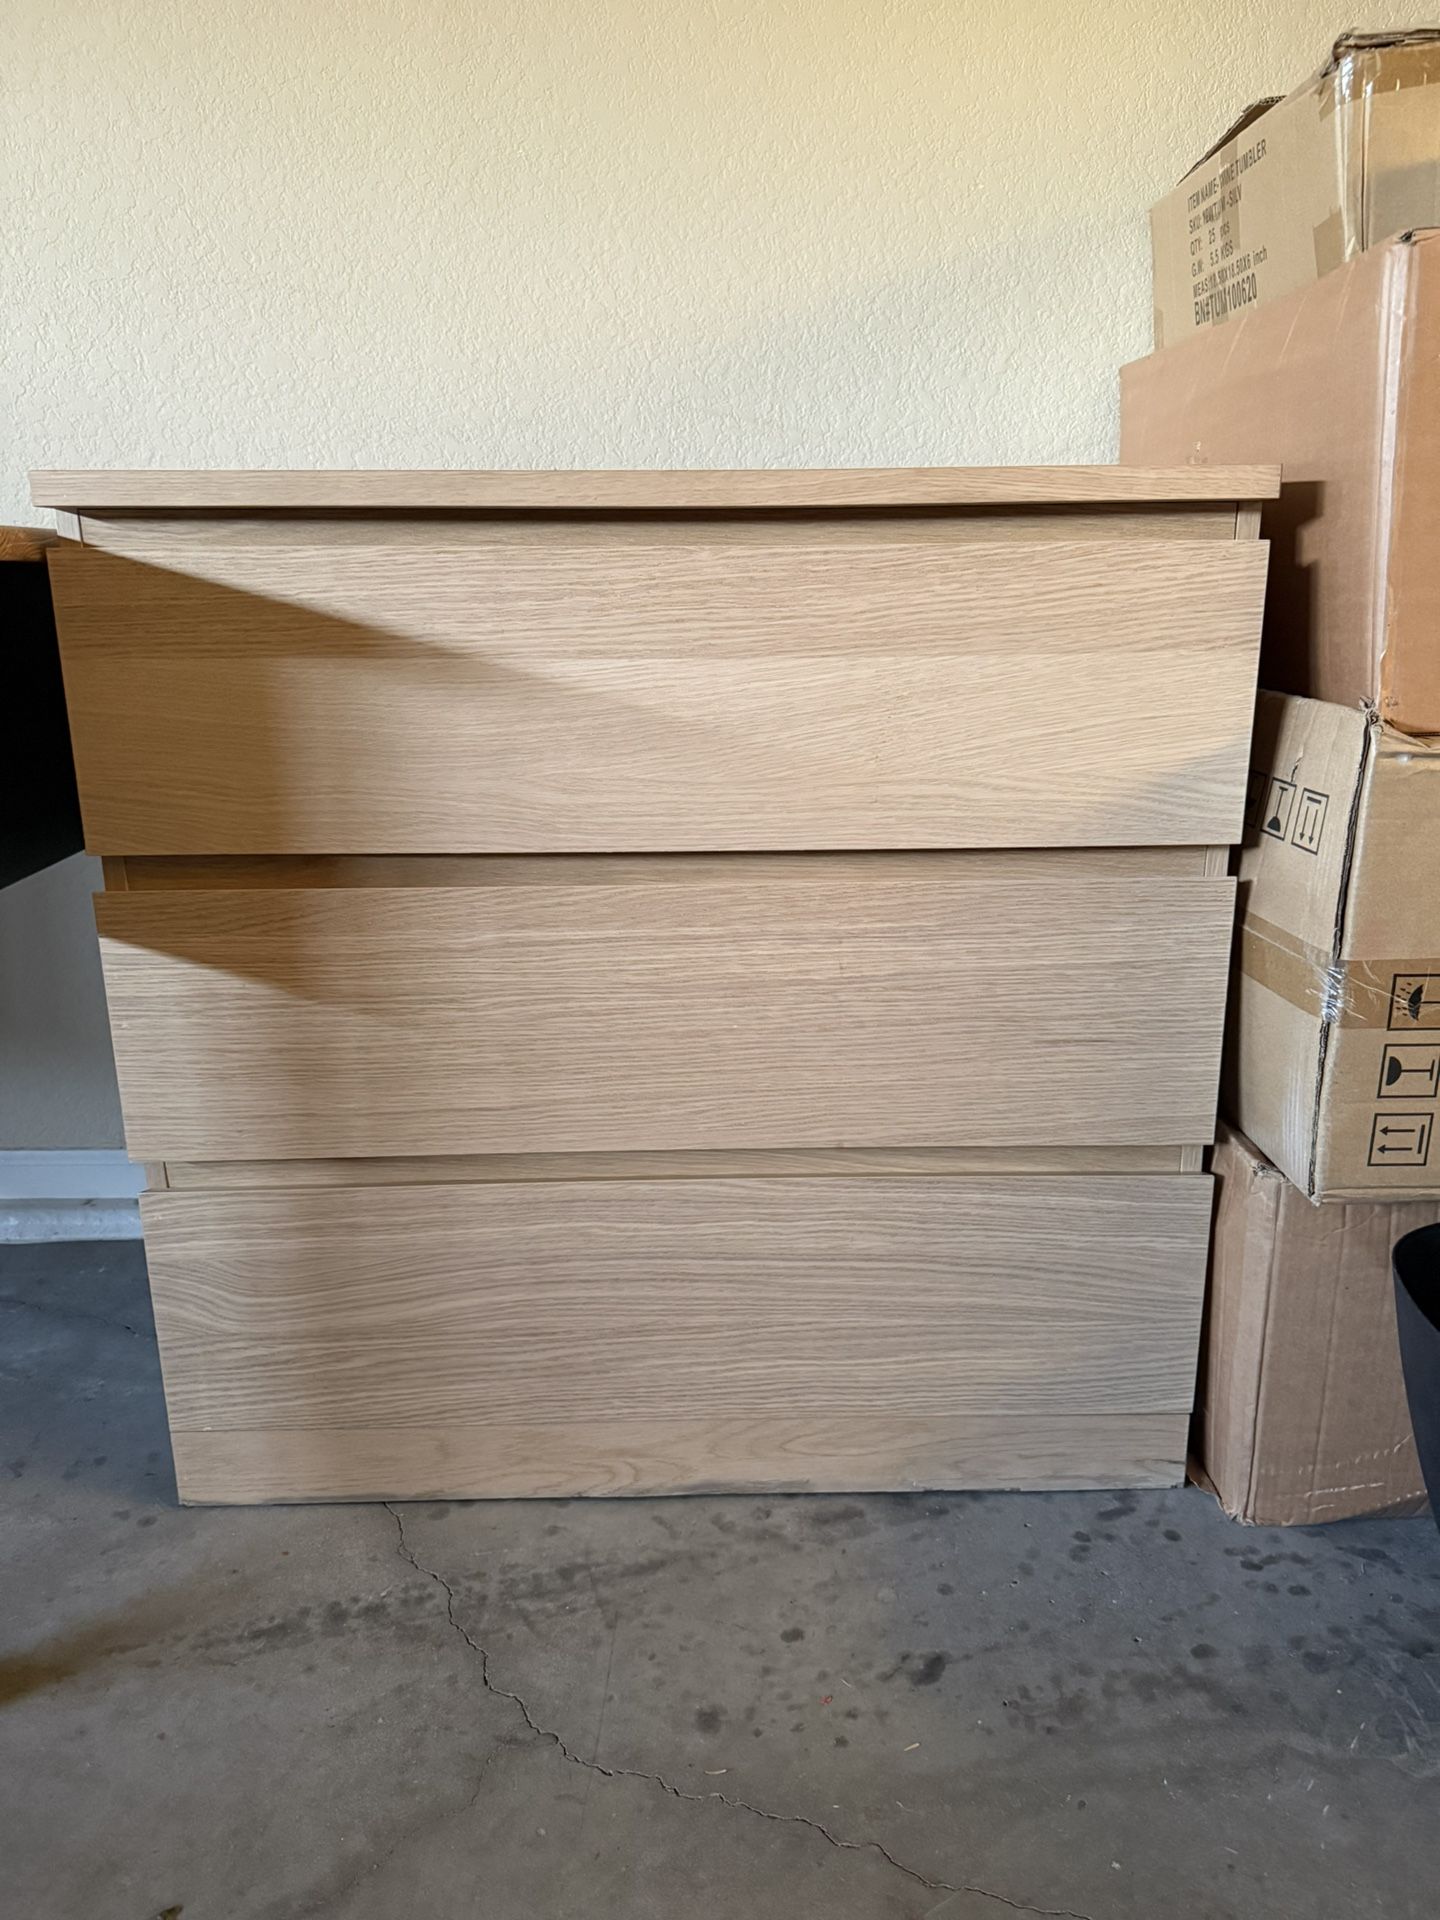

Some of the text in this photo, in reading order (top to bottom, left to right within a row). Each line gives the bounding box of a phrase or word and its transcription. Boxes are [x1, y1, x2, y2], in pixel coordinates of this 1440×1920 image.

[1187, 190, 1200, 213] ITEM
[1208, 227, 1216, 245] 25
[1210, 248, 1219, 267] 5.5
[1220, 239, 1234, 261] KGS
[1252, 244, 1268, 266] inch
